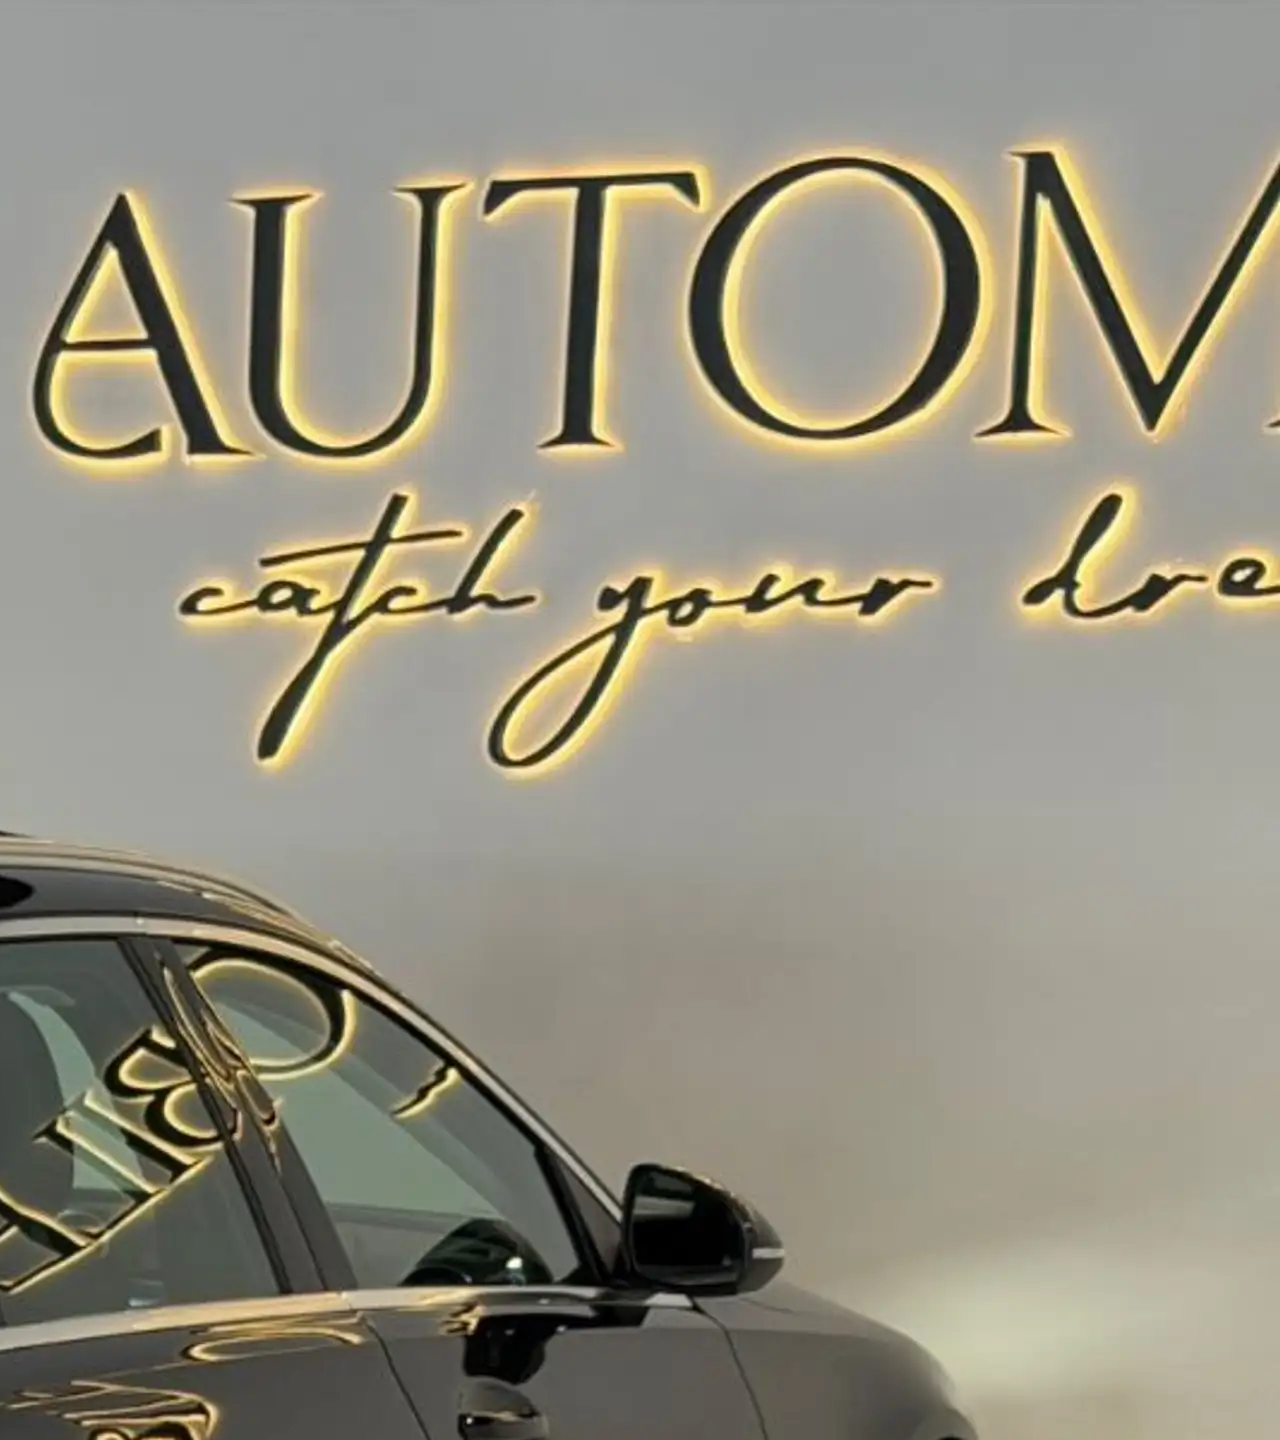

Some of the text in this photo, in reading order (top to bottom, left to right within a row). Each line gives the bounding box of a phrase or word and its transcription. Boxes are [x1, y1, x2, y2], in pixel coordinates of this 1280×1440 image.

[32, 149, 1280, 457] AUTOM
[179, 494, 1280, 768] catch your dre
